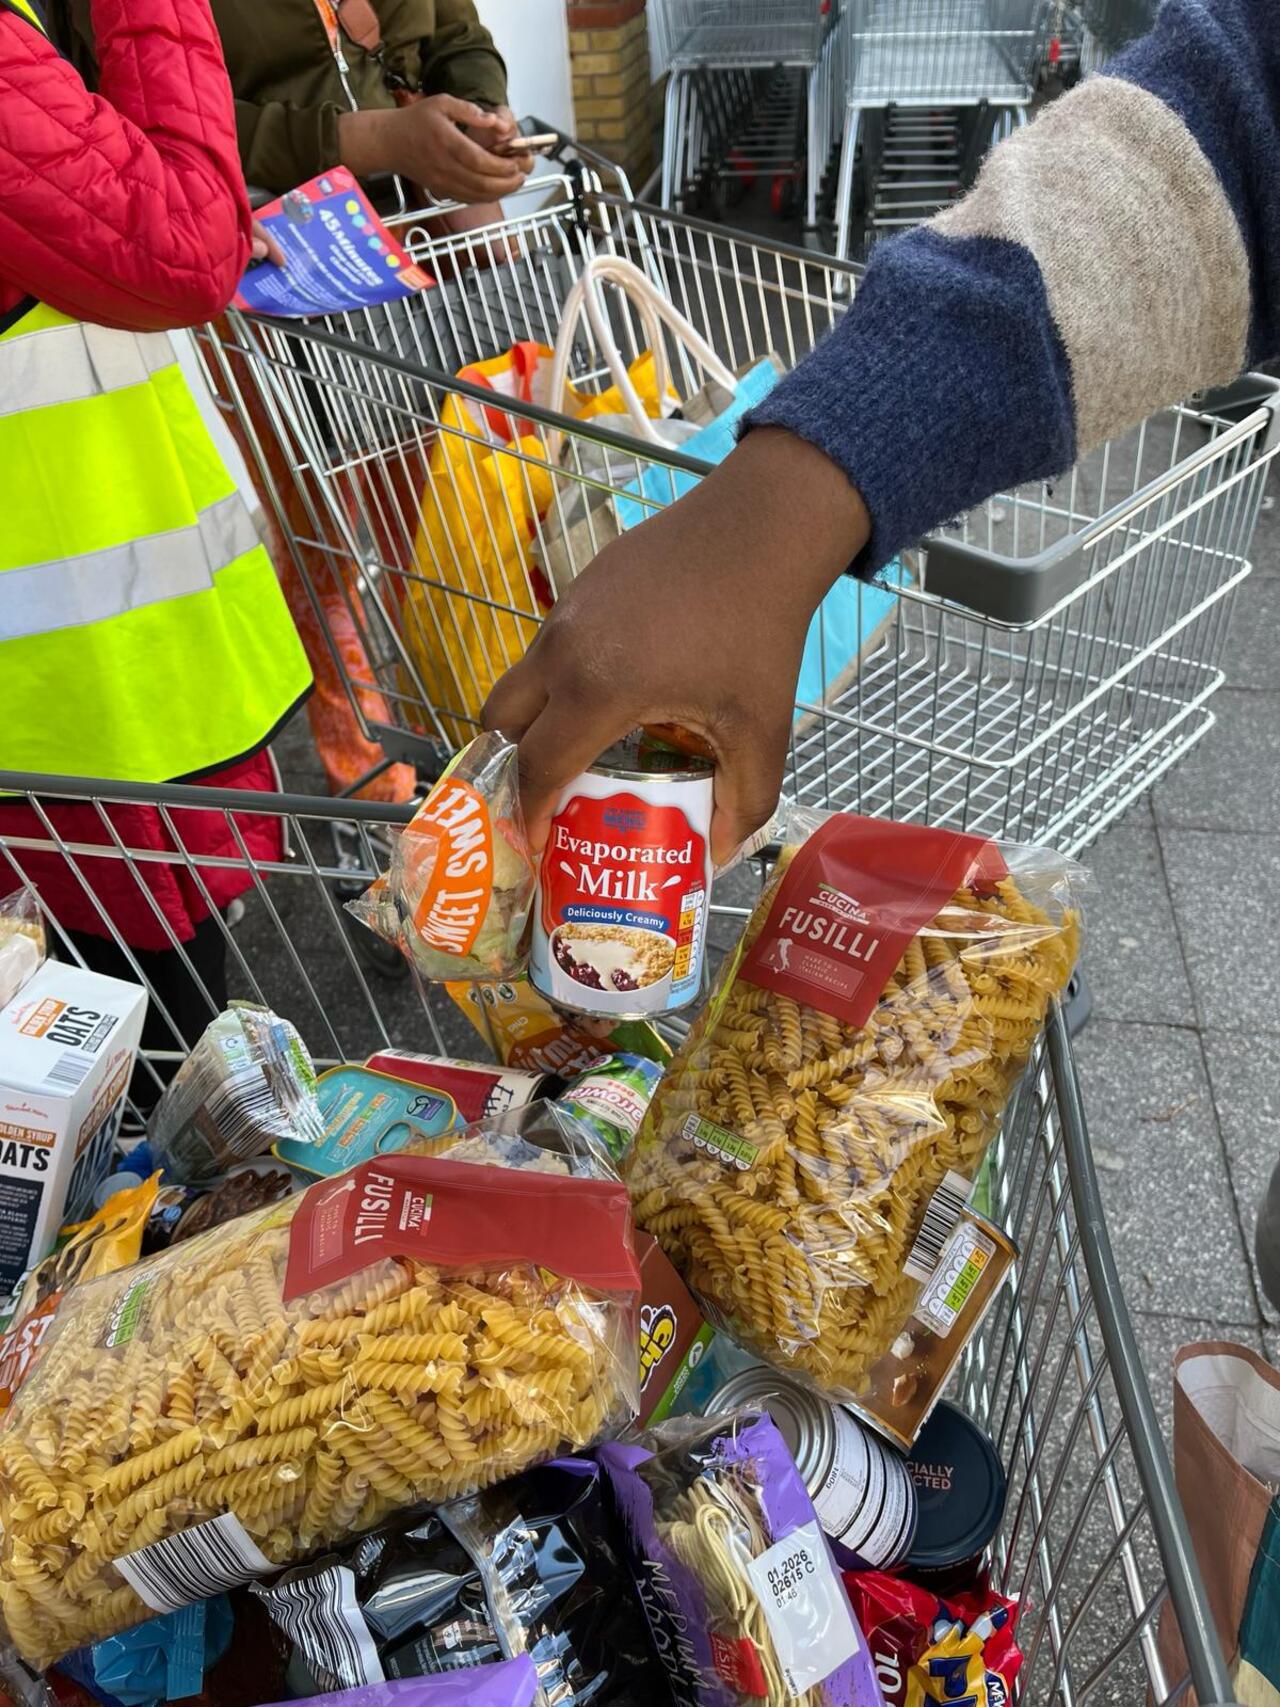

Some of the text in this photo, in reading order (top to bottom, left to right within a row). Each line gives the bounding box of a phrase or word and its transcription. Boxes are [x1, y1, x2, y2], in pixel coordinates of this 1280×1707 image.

[319, 209, 340, 231] 45
[555, 825, 692, 865] Evaporated
[576, 863, 660, 902] Milk
[421, 888, 484, 953] SWEET
[567, 907, 665, 929] Deliciously Creamy
[818, 890, 867, 920] CUCINA
[778, 907, 880, 963] FUSILLI
[46, 1006, 101, 1047] OATS
[354, 1172, 395, 1245] FUSILLI
[407, 1196, 425, 1230] CUCINA
[907, 1460, 954, 1478] CIALLY
[914, 1477, 952, 1490] CTED
[767, 1549, 809, 1584] 01.2026
[772, 1560, 816, 1597] 02615 C
[641, 1559, 712, 1690] MEDIUM
